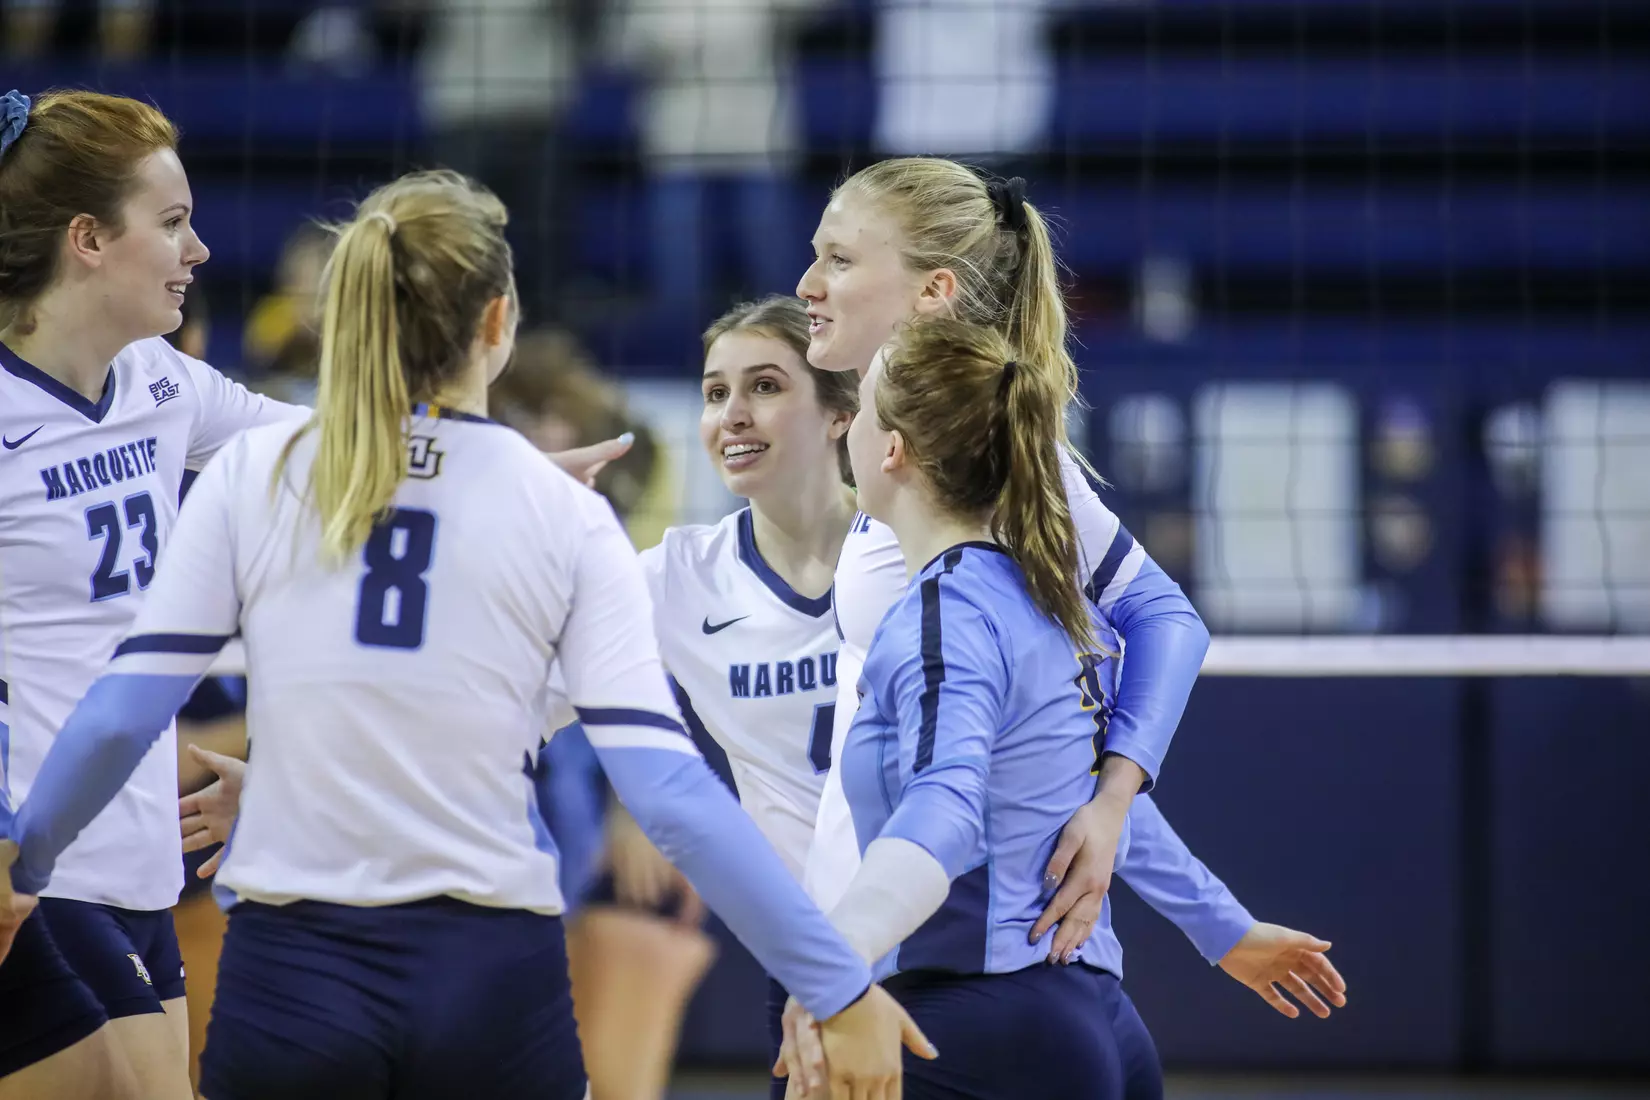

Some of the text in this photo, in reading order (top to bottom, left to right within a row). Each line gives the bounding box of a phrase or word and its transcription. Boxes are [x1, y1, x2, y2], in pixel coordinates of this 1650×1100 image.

[149, 376, 170, 393] BIG
[153, 383, 180, 402] EAST
[39, 436, 158, 502] MARQUETTE
[84, 490, 158, 603] 23
[354, 506, 439, 651] 8
[729, 651, 839, 698] MARQU
